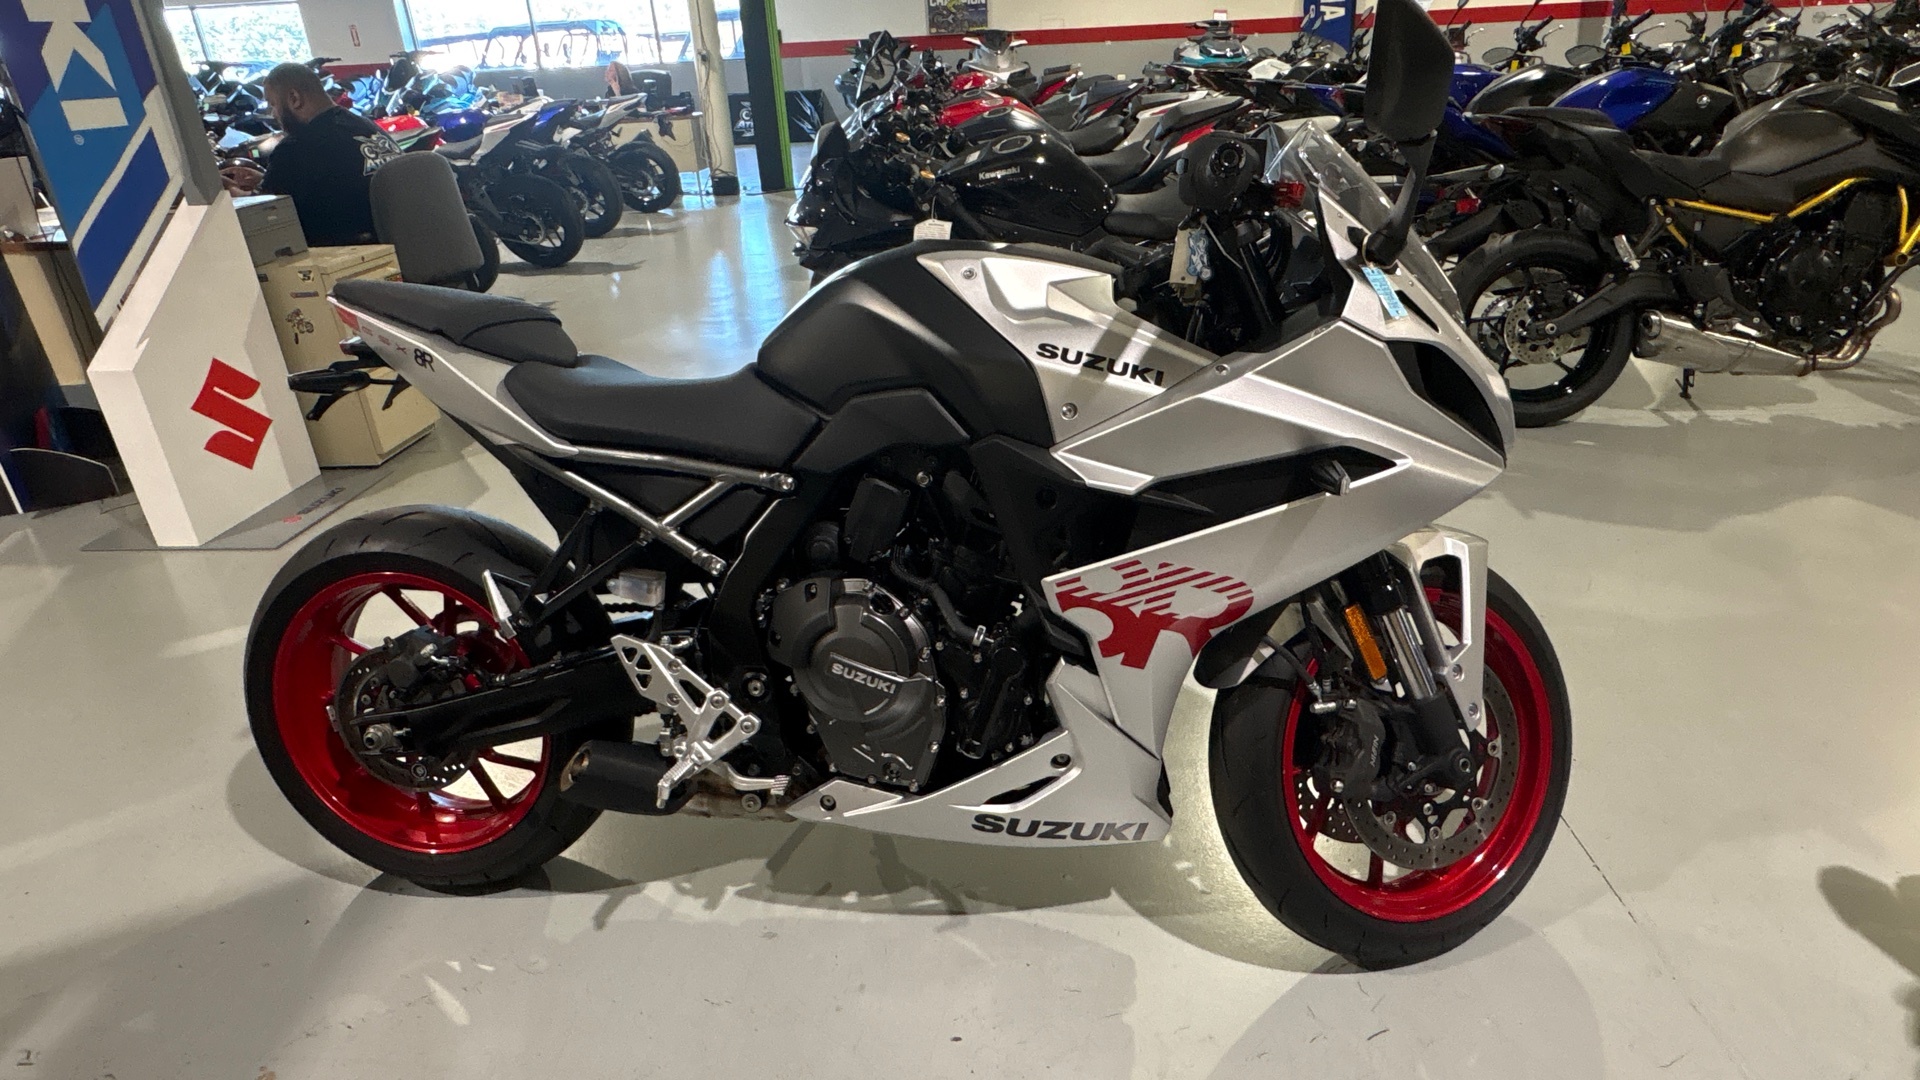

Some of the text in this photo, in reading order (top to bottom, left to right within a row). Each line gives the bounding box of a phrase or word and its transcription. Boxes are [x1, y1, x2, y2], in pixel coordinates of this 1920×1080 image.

[1036, 342, 1165, 386] SUZUKI
[831, 662, 897, 694] SUZUKI
[971, 813, 1149, 841] SUZUKI
